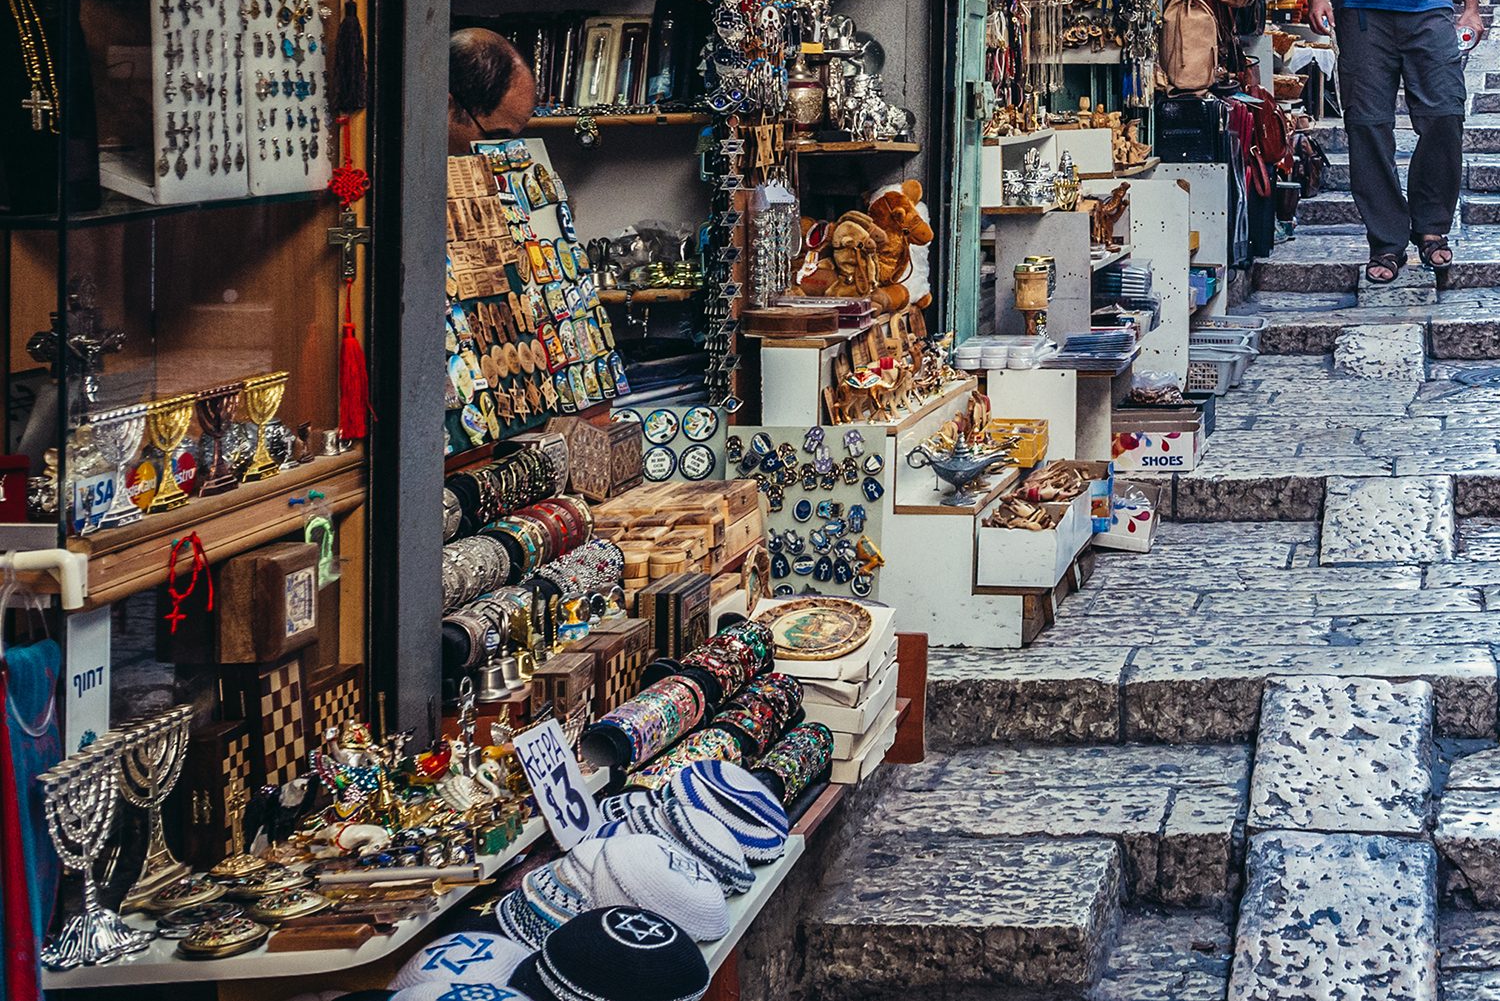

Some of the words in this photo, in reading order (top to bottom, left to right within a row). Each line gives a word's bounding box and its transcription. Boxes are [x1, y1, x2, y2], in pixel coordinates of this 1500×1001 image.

[1141, 455, 1184, 466] SHOES
[73, 666, 104, 698] דחוף
[515, 726, 567, 788] KEEPA
